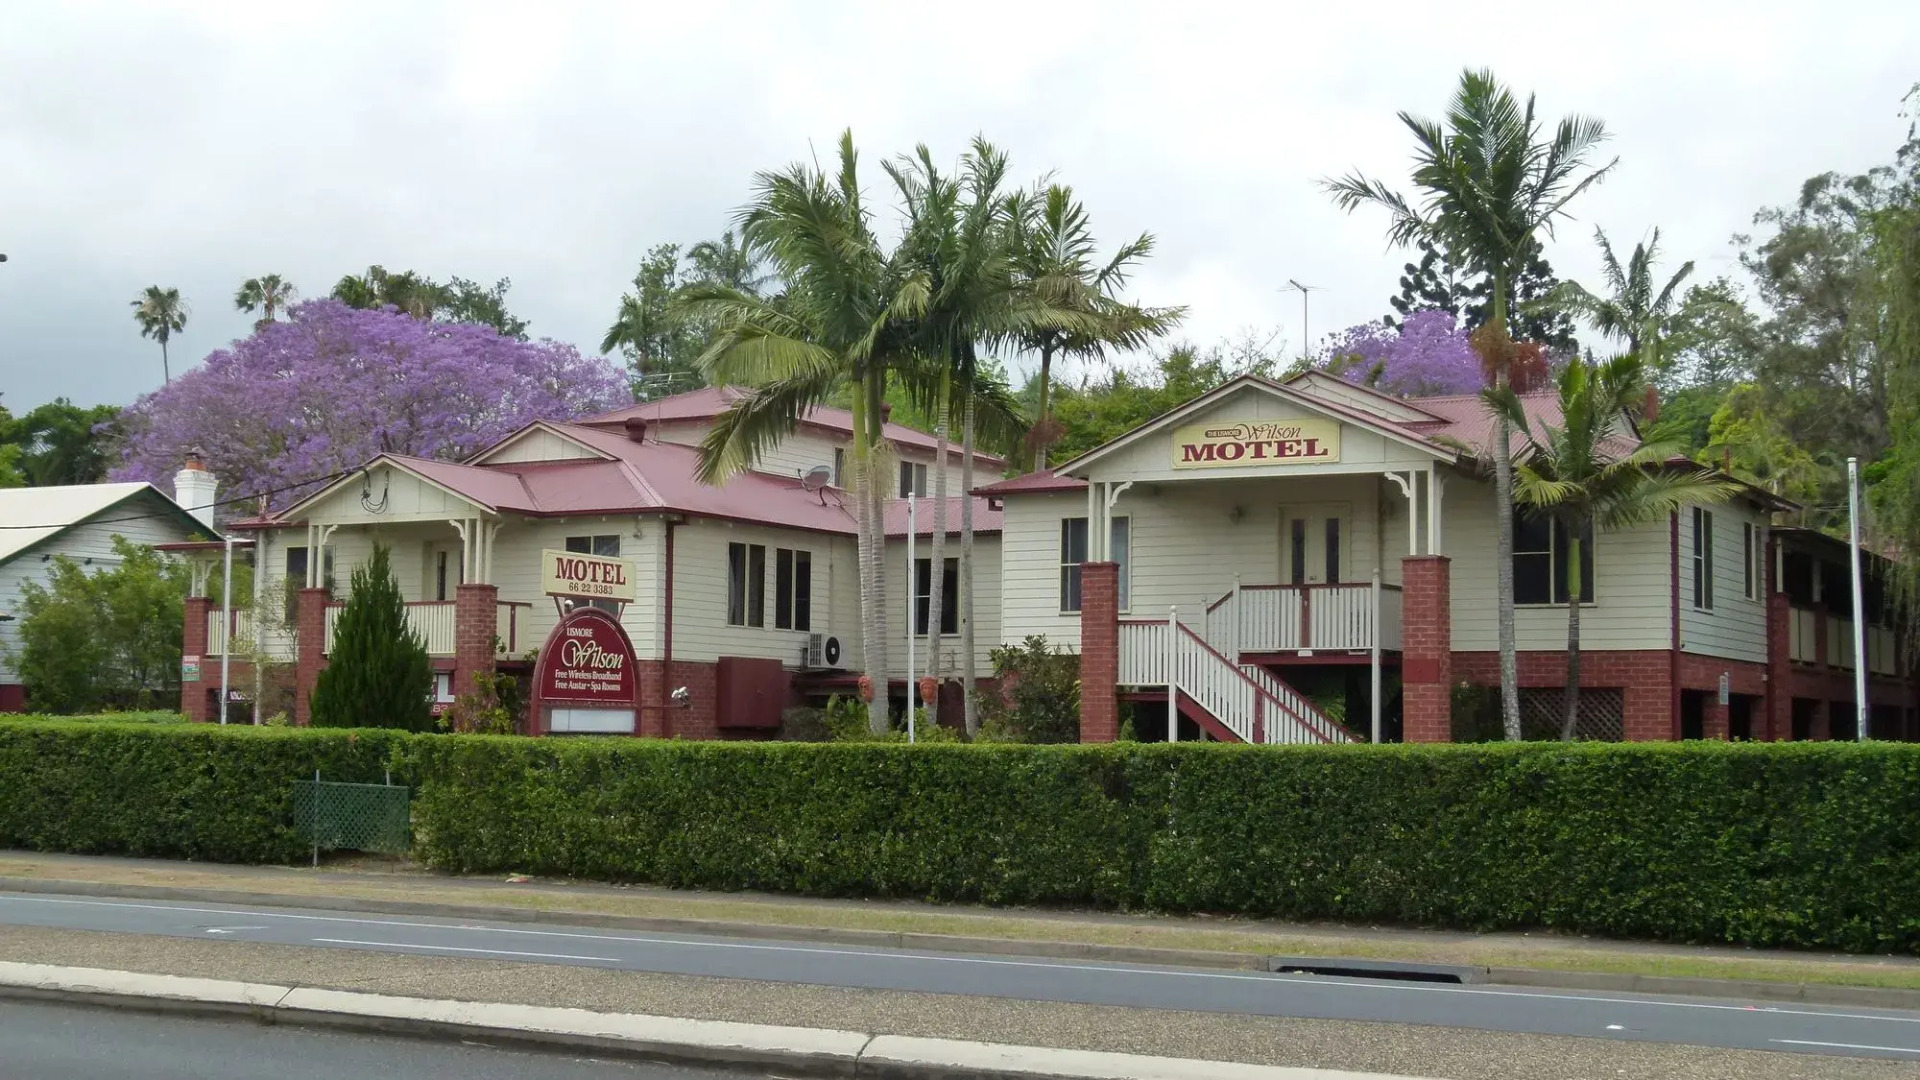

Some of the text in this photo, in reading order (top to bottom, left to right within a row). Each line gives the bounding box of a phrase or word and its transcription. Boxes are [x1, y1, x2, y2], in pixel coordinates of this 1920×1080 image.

[1234, 423, 1301, 440] Wilson
[1181, 438, 1328, 462] MOTEL
[555, 557, 626, 586] MOTEL
[568, 582, 613, 595] 66 22 3383
[566, 628, 593, 638] LISMORE
[561, 639, 624, 669] Wilson
[555, 669, 622, 681] Free Wireless Broadband
[555, 680, 568, 689] Free
[590, 681, 601, 693] Spa
[601, 682, 621, 691] Rooms
